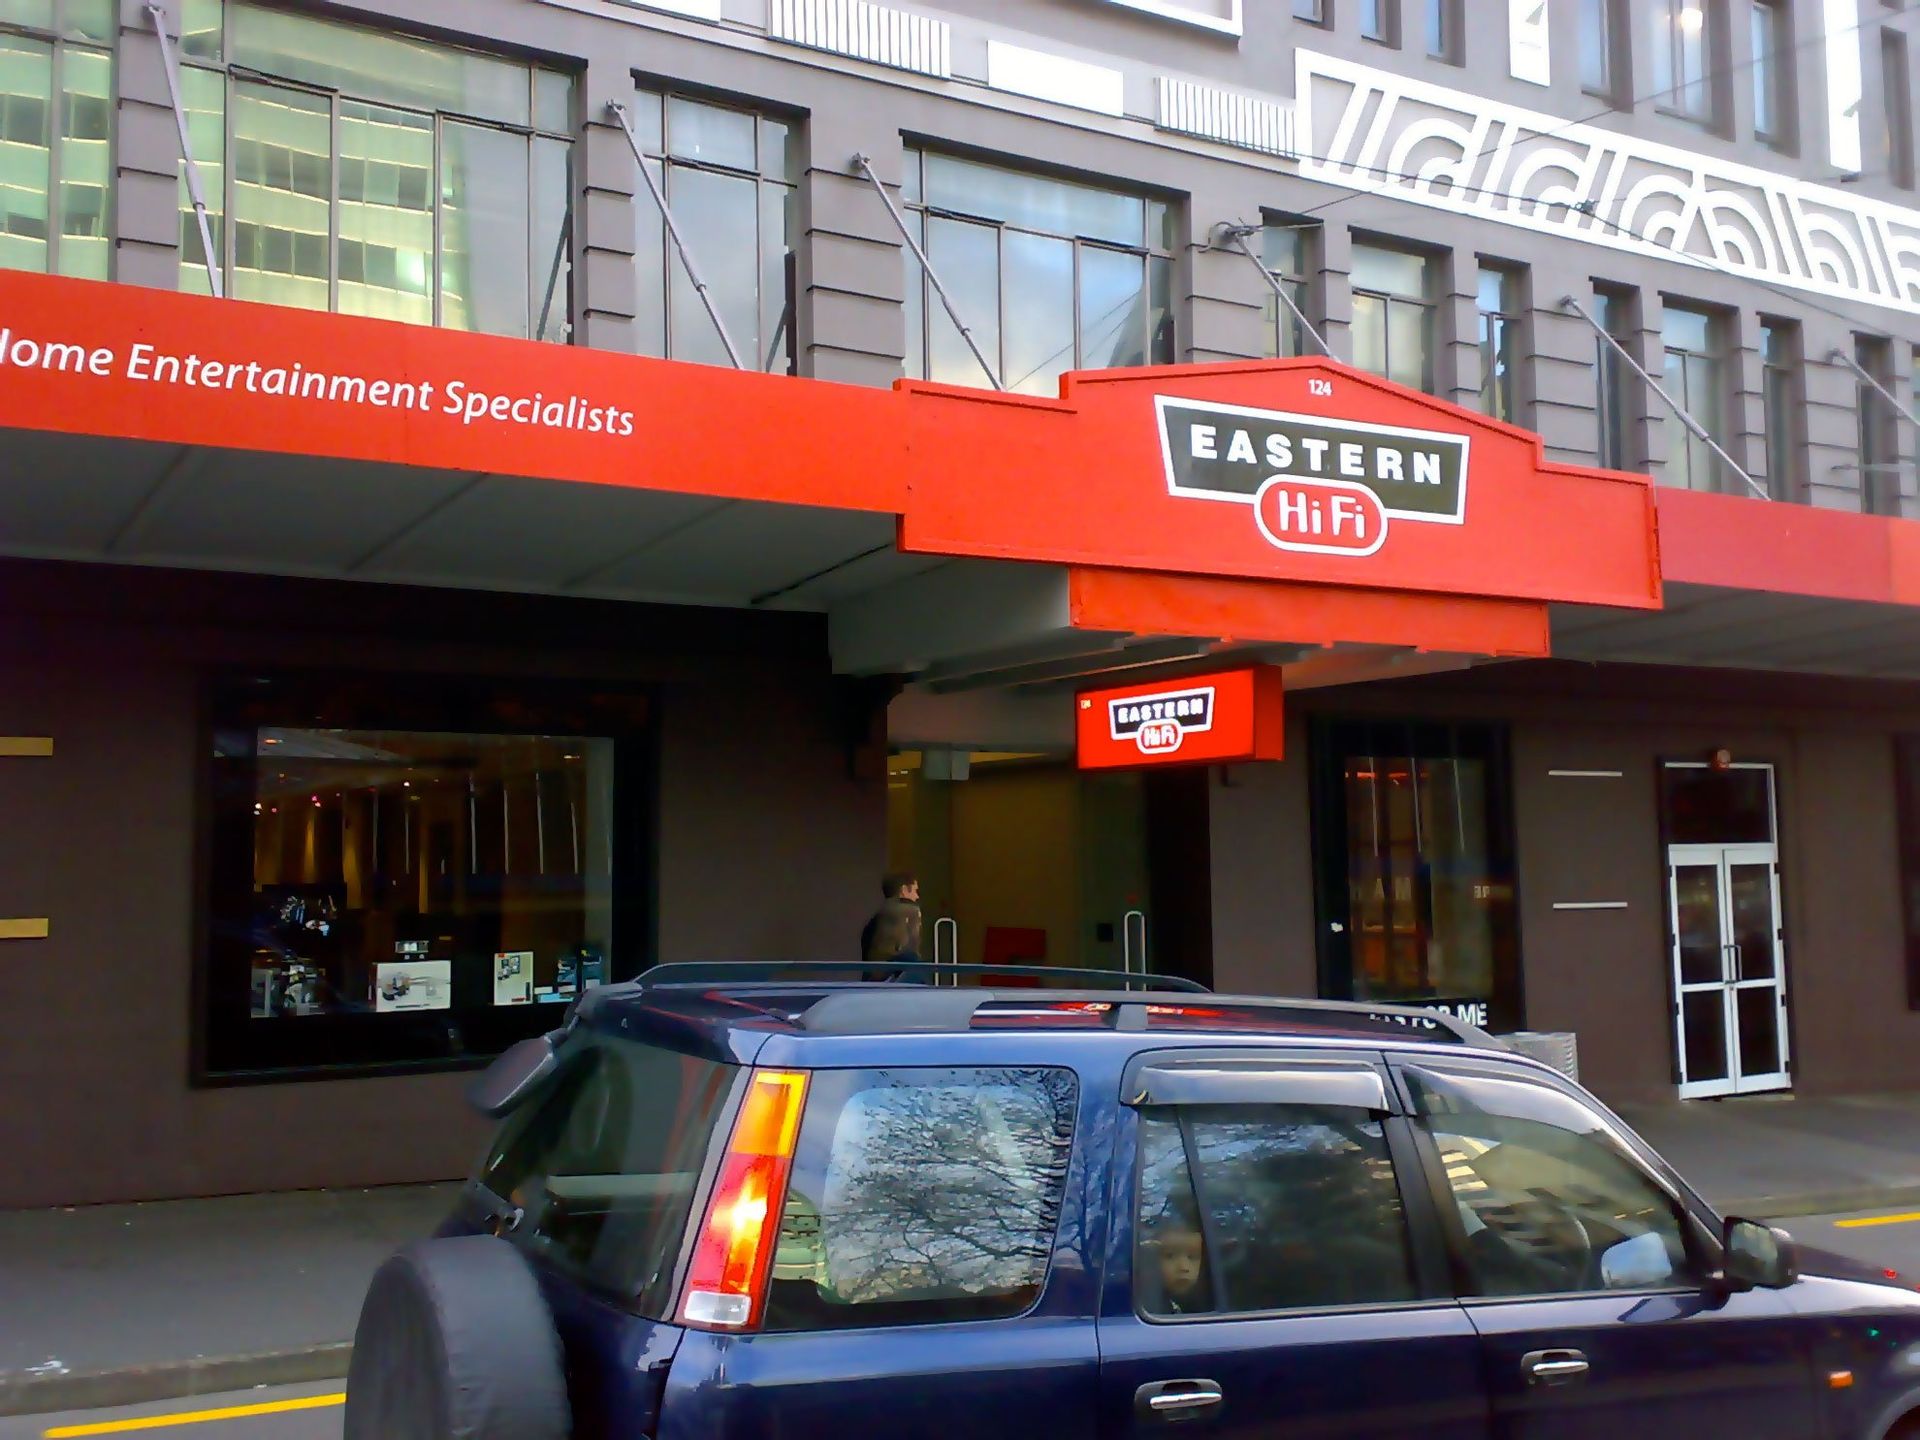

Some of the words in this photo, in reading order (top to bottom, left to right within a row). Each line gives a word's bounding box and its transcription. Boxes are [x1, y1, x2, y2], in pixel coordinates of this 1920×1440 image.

[126, 343, 433, 411] Entertainment
[442, 381, 634, 436] Specialists
[1308, 378, 1333, 397] 124
[1190, 423, 1441, 485] EASTERN
[1117, 697, 1204, 725] EASTERN
[1457, 1003, 1488, 1026] ME
